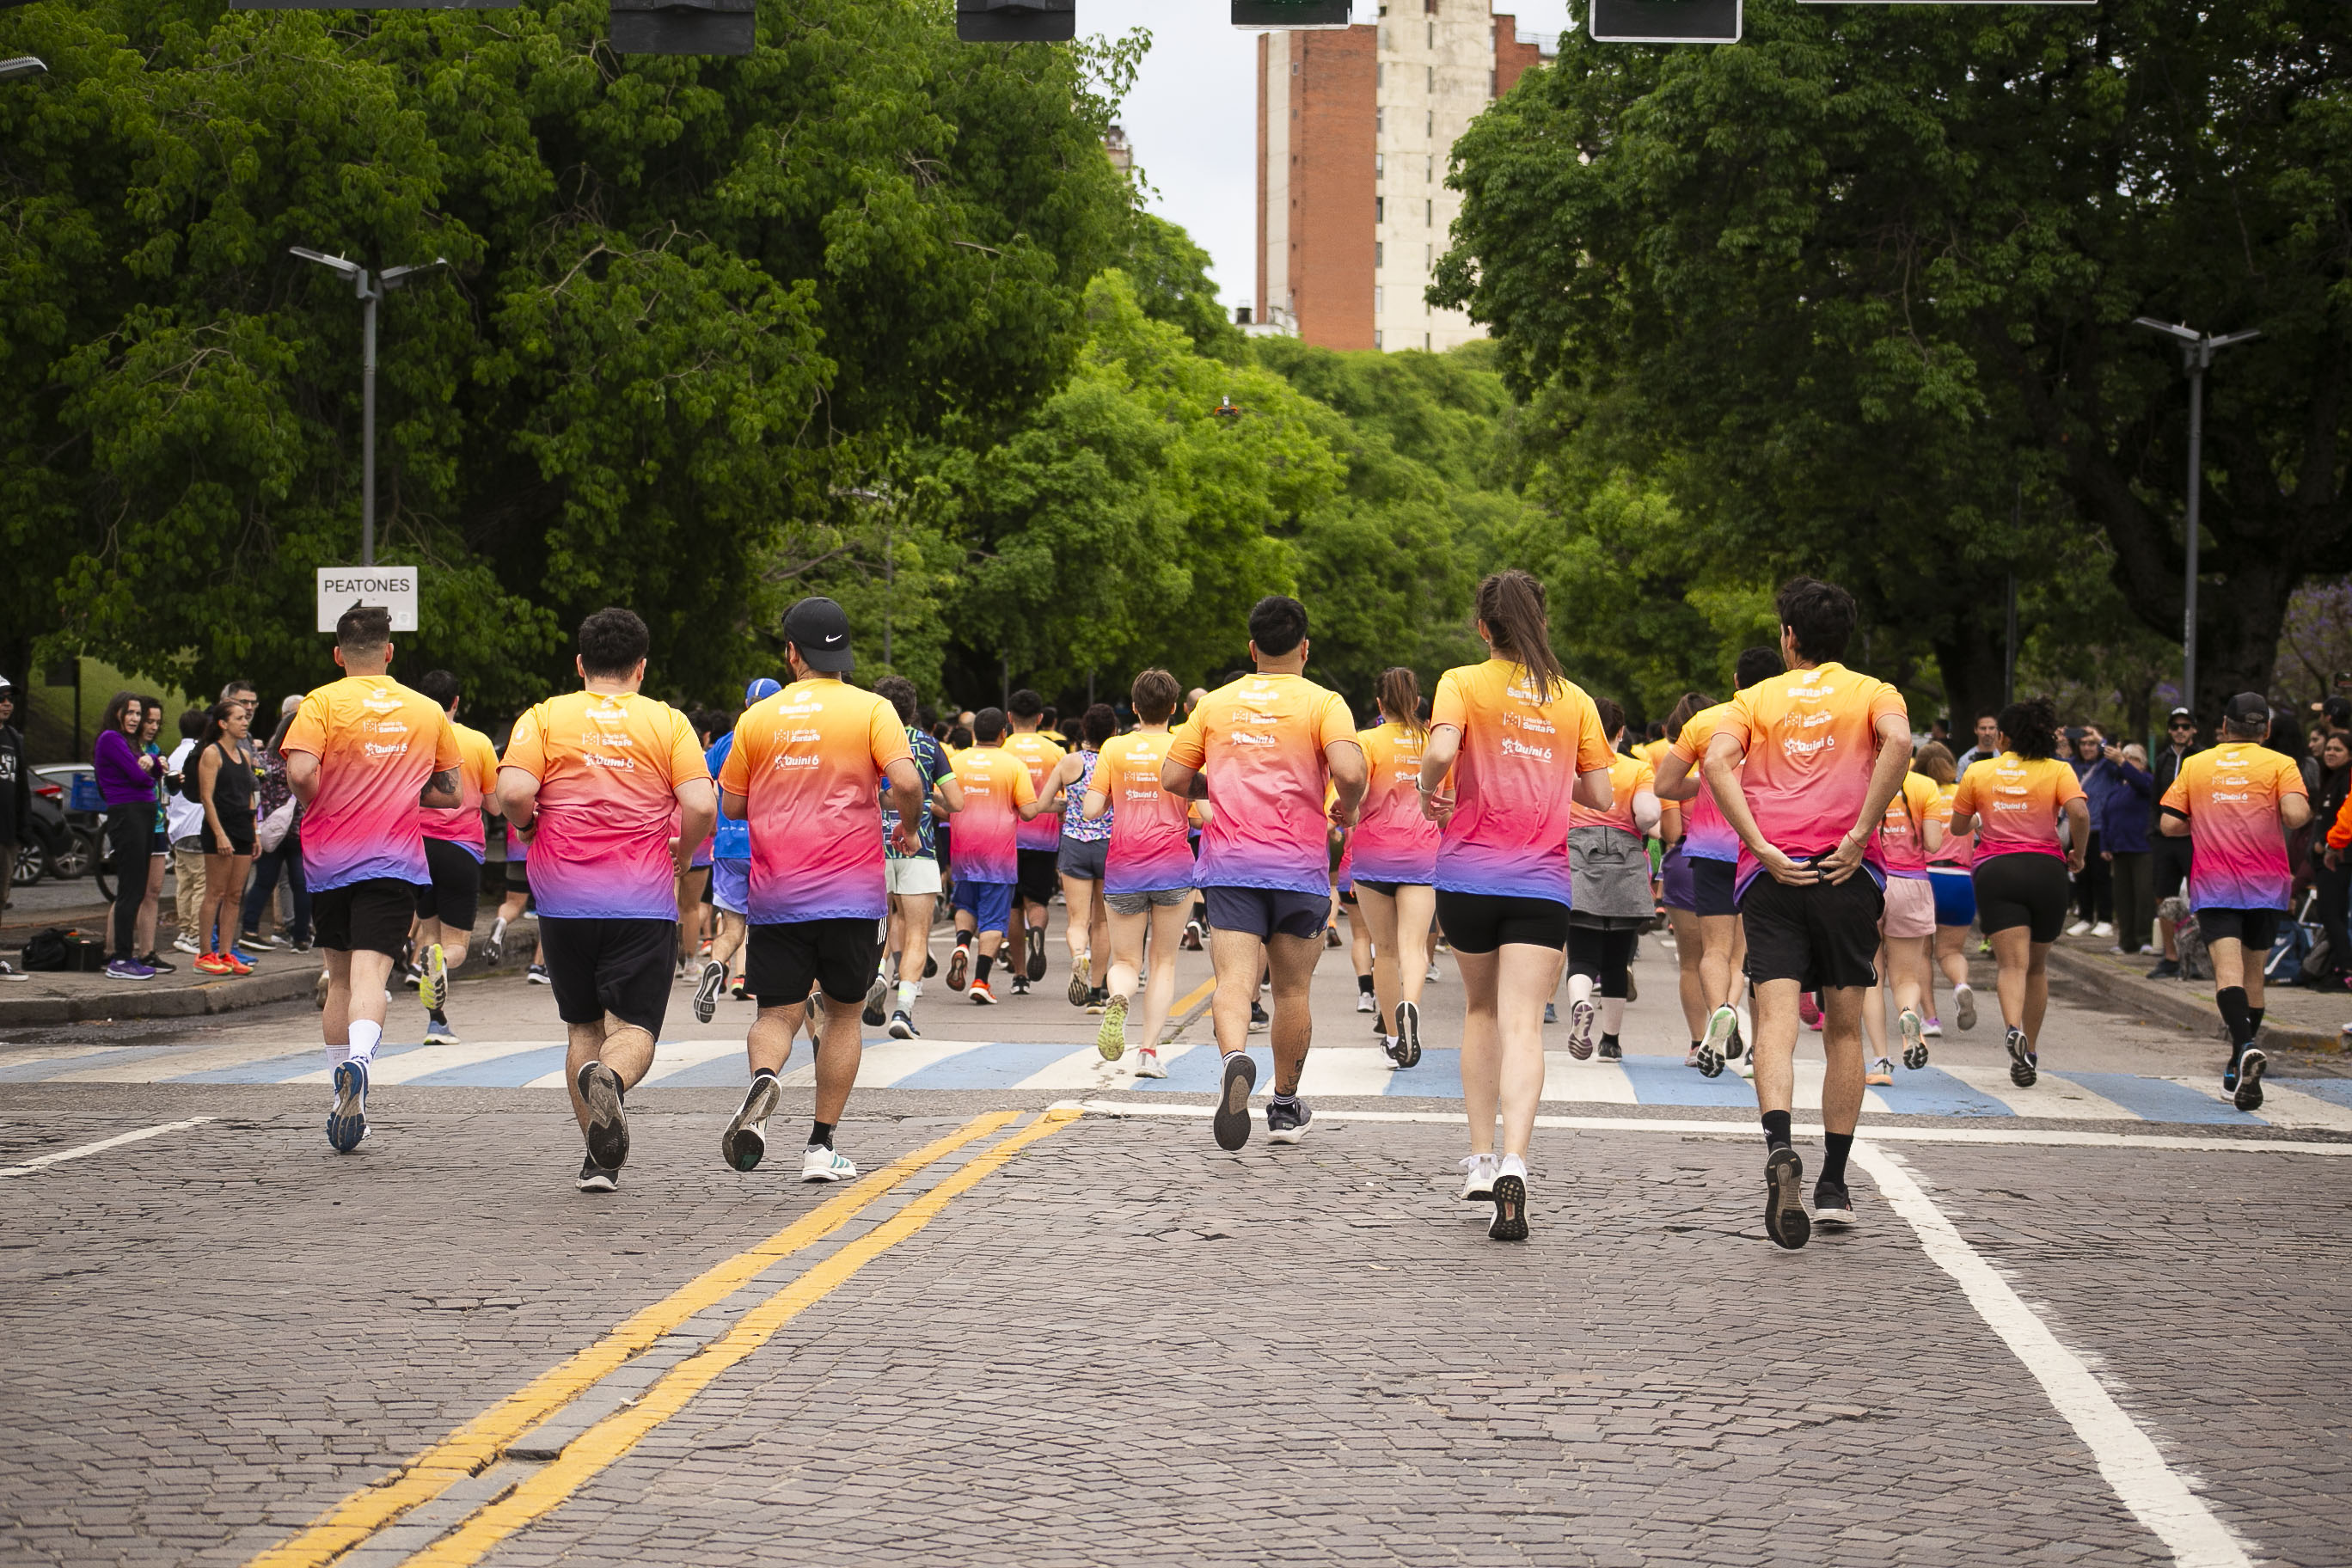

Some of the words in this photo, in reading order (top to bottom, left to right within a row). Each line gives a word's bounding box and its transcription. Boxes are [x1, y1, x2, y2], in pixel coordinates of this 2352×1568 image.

[324, 579, 410, 592] PEATONES
[1787, 688, 1821, 697] Santa
[1822, 686, 1834, 695] Fe
[1522, 722, 1546, 732] Santa
[1269, 734, 1275, 744] 6
[1798, 738, 1824, 751] Quini
[1827, 736, 1834, 746] 6
[375, 744, 400, 753] Quini
[401, 743, 407, 752] 6
[1515, 741, 1543, 756] Quini
[1544, 749, 1552, 759] 6
[597, 755, 625, 768] Quini
[627, 758, 634, 769] 6
[785, 756, 811, 765] Quini
[812, 755, 818, 765] 6
